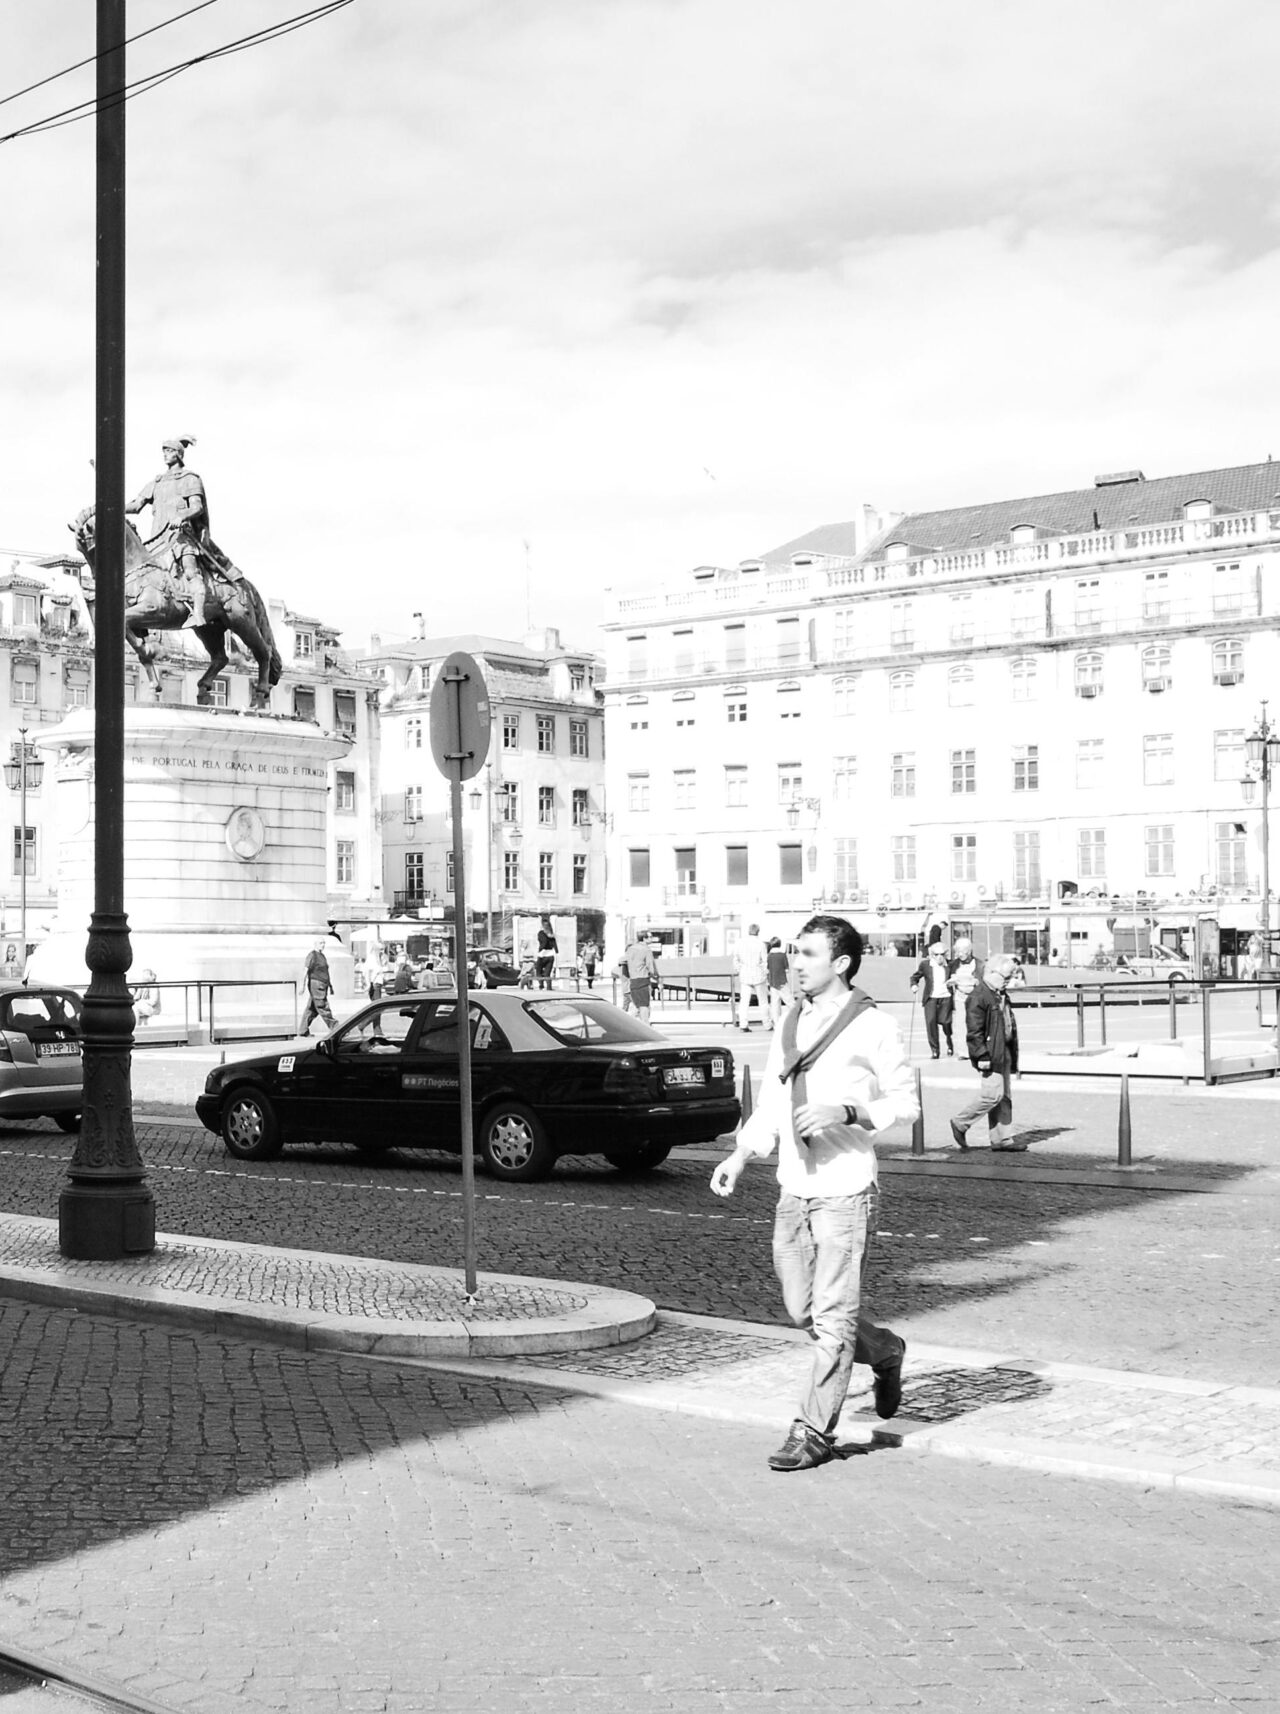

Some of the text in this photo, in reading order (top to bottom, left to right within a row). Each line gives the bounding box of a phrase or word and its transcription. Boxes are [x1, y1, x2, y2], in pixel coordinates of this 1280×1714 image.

[152, 757, 197, 768] PORTUGAL
[202, 760, 220, 769] PELA
[225, 760, 253, 772] GRAÇA
[258, 764, 268, 773] DE
[272, 765, 289, 774] DEUS
